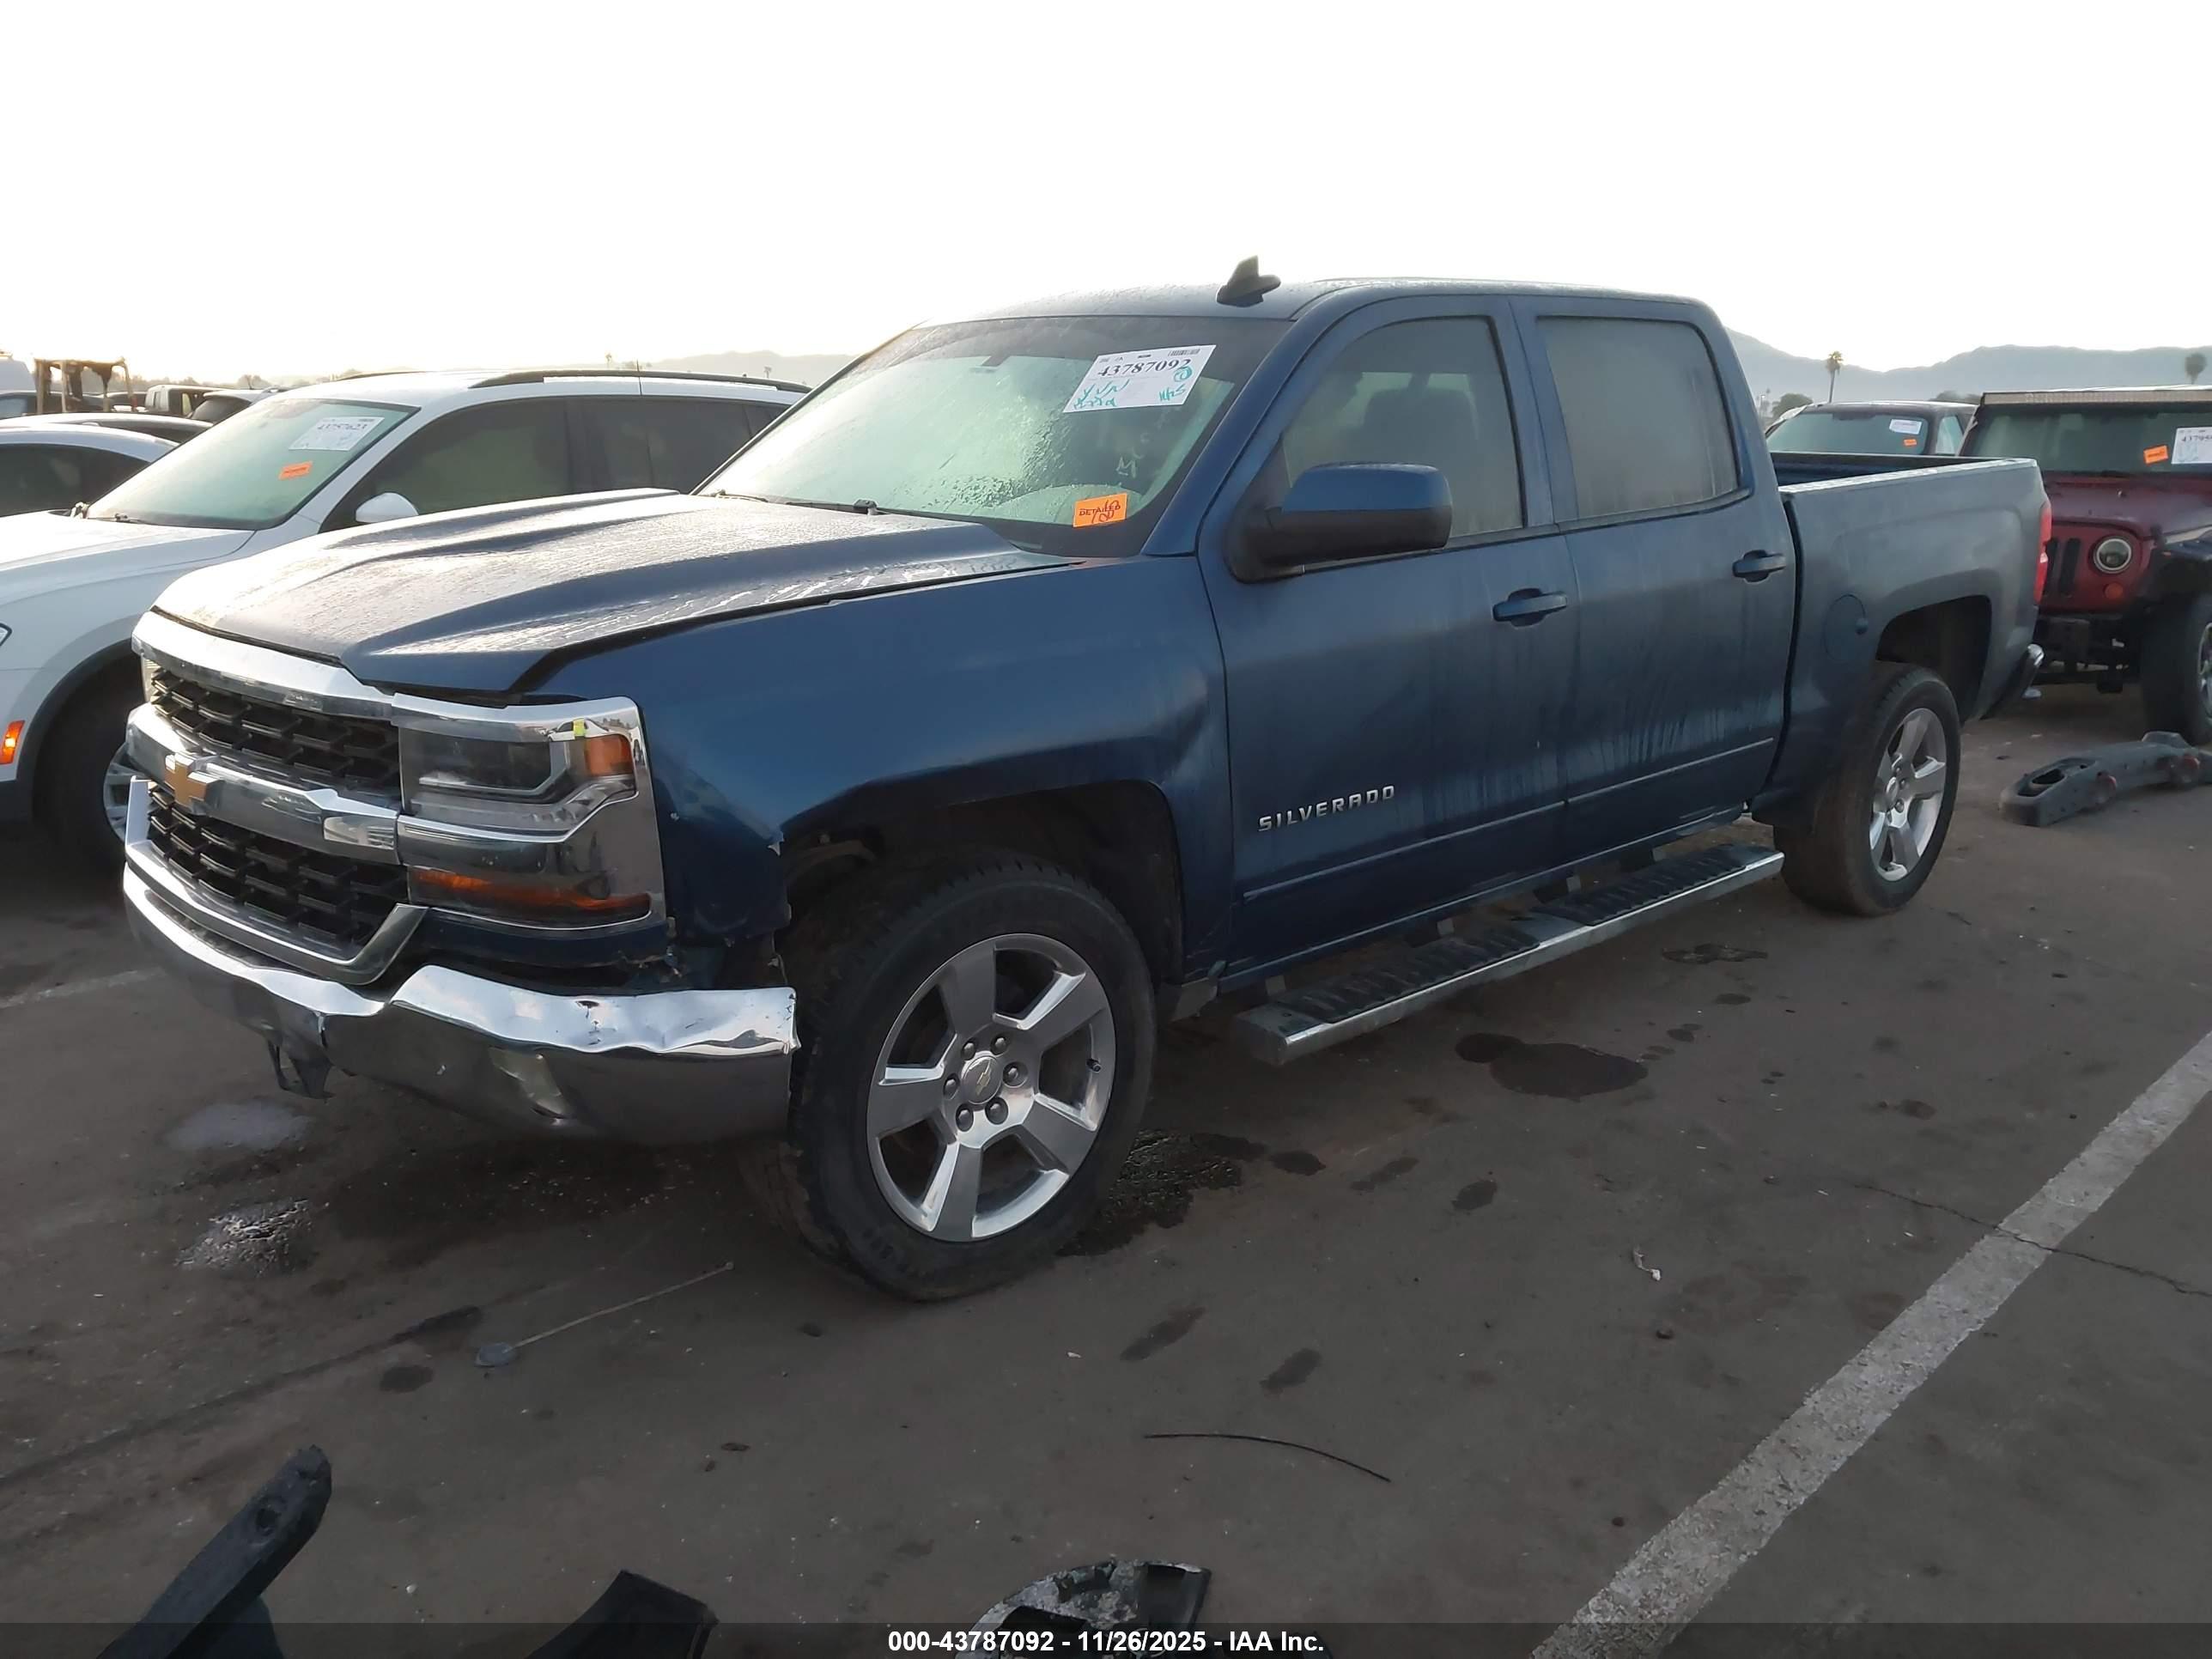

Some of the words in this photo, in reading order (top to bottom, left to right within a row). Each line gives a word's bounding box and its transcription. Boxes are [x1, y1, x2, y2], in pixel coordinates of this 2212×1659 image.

[1098, 358, 1192, 377] 43787092
[1079, 505, 1121, 516] DETAILED
[1258, 785, 1395, 832] SILVERADO
